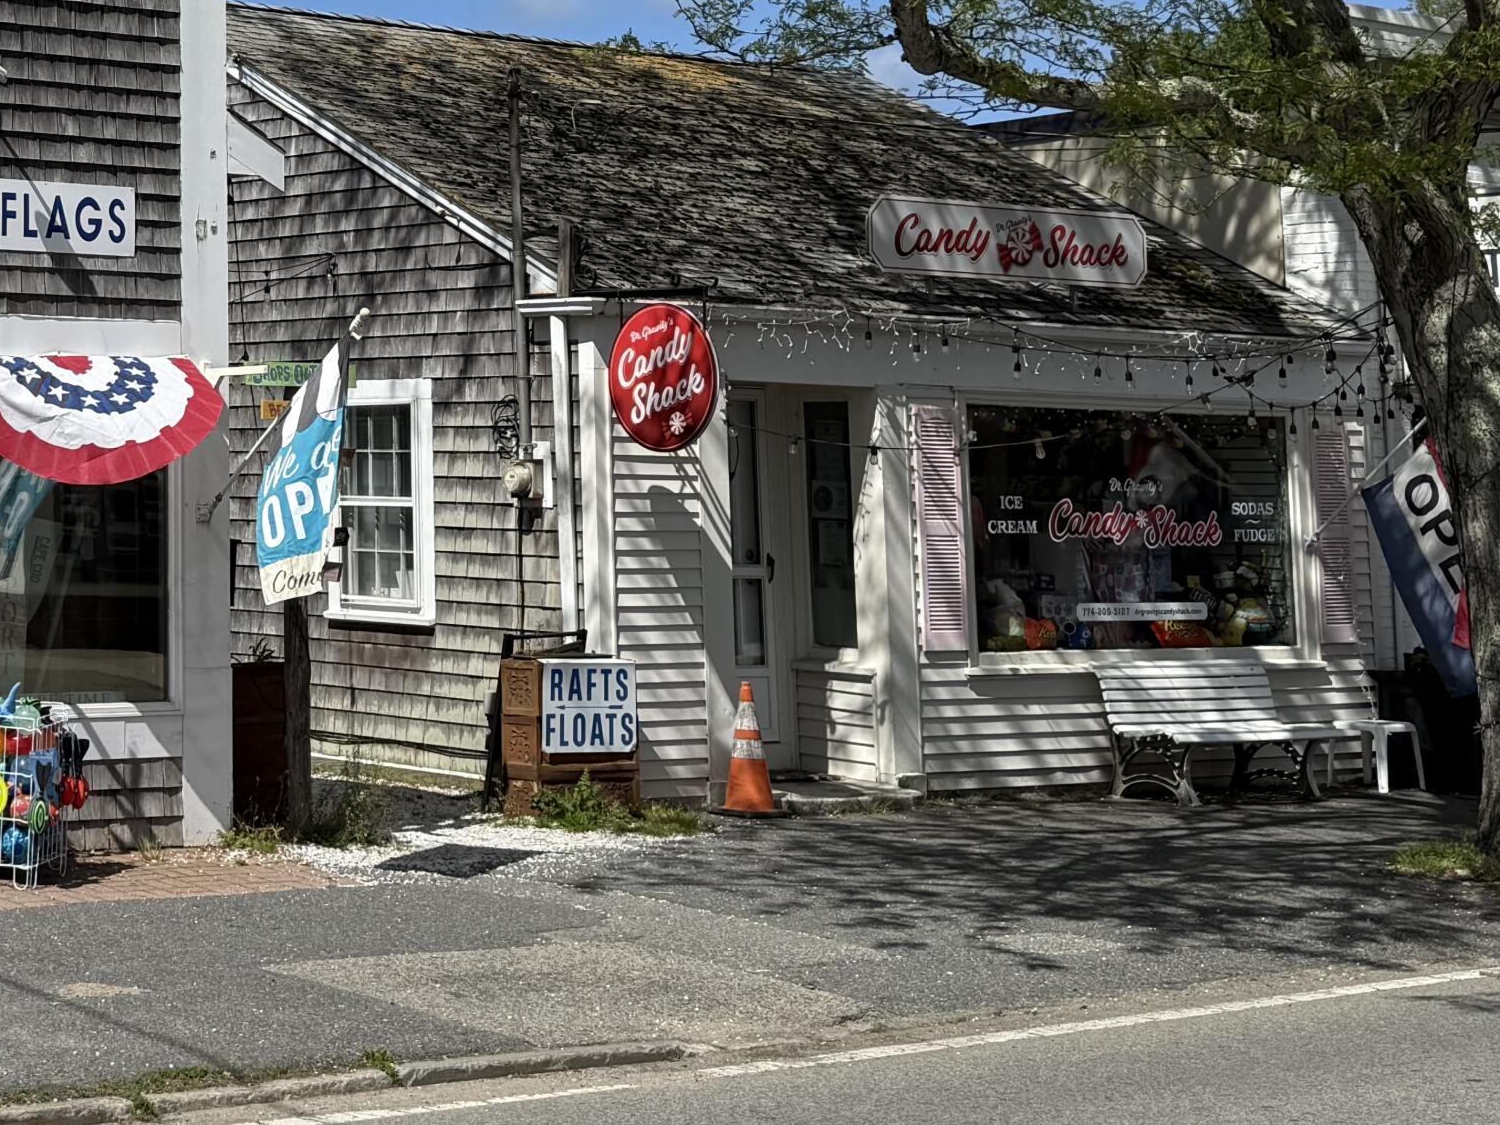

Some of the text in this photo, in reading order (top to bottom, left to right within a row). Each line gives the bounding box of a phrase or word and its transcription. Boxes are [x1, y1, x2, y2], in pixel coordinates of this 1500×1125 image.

[1, 192, 126, 243] FLAGS
[894, 212, 991, 263] Candy
[1043, 225, 1129, 269] Shack
[618, 326, 692, 388] Candy
[631, 363, 705, 424] Shack
[263, 445, 299, 497] We
[1000, 495, 1023, 509] ICE
[1049, 498, 1222, 549] Candy Shack
[1231, 502, 1274, 516] SODAS
[988, 520, 1038, 534] CREAM
[1234, 529, 1275, 542] FUDGE
[550, 668, 628, 701] RAFTS
[546, 712, 634, 747] FLOATS
